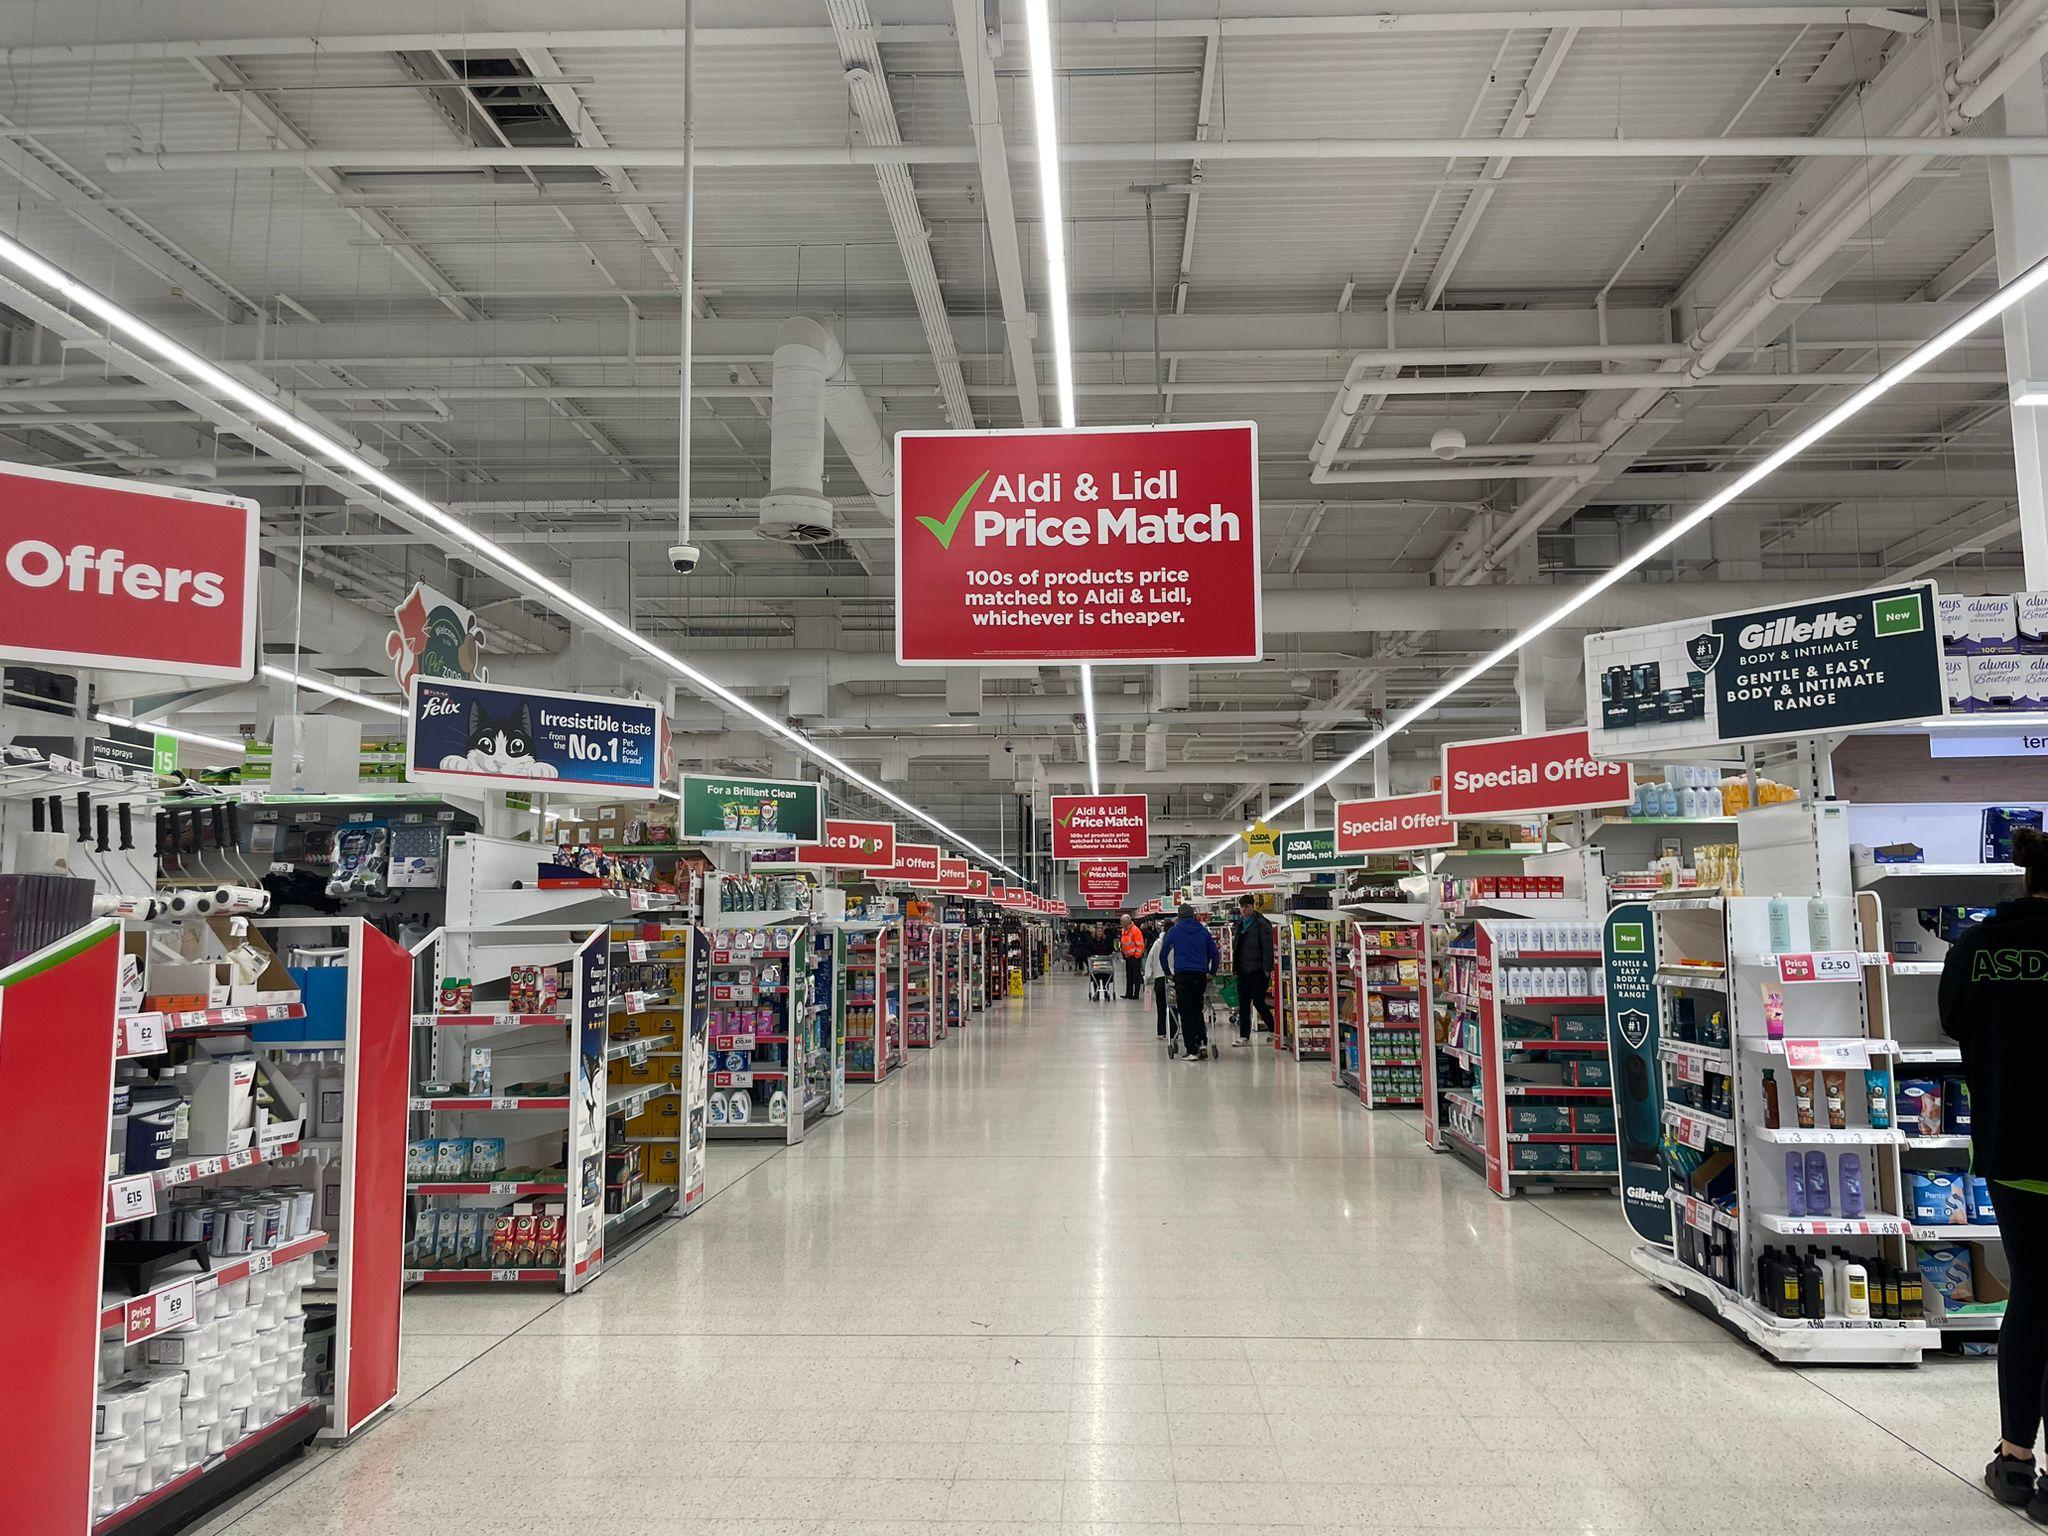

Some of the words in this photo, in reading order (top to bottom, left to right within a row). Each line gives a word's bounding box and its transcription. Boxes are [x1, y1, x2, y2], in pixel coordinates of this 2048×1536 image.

[988, 473, 1061, 503] Aldi
[1073, 472, 1099, 502] &
[1112, 469, 1178, 500] Lidl
[974, 508, 1092, 547] Price
[1097, 503, 1240, 545] Match
[6, 540, 225, 607] Offers
[966, 570, 1013, 586] 100s
[1018, 569, 1039, 585] of
[1044, 569, 1134, 588] products
[1140, 567, 1190, 586] price
[965, 590, 1051, 605] matched
[1057, 591, 1079, 604] to
[1084, 589, 1124, 604] Aldi
[1129, 588, 1144, 603] &
[1149, 587, 1192, 605] Lidl,
[1968, 599, 2008, 614] always
[972, 610, 1073, 626] whichever
[1078, 609, 1095, 624] is
[1100, 609, 1185, 626] cheaper.
[1885, 609, 1910, 622] New
[1739, 612, 1857, 650] Gillette
[1696, 643, 1713, 656] #1
[1740, 652, 1775, 666] BODY
[1781, 650, 1790, 660] &
[1794, 640, 1859, 658] INTIMATE
[1737, 668, 1799, 686] GENTLE
[1806, 666, 1819, 678] &
[1825, 657, 1871, 675] EASY
[1979, 658, 2020, 674] always
[1727, 686, 1773, 702] BODY
[1780, 684, 1792, 696] &
[1799, 670, 1885, 694] INTIMATE
[421, 697, 461, 720] felix
[1774, 693, 1836, 711] RANGE
[540, 709, 619, 732] Irresistible
[622, 721, 652, 736] taste
[548, 731, 566, 741] from
[622, 738, 634, 747] Pet
[553, 741, 566, 750] the
[568, 733, 618, 763] No.1
[622, 747, 638, 756] Food
[111, 746, 133, 760] sprays
[157, 751, 173, 771] 15
[1454, 762, 1538, 793] Special
[1544, 757, 1621, 781] Offers
[707, 784, 724, 795] For
[725, 788, 731, 796] a
[733, 786, 769, 798] Brilliant
[771, 787, 797, 799] Clean
[1076, 807, 1096, 815] Aldi
[1098, 806, 1106, 815] &
[1108, 806, 1127, 815] Lidl
[1072, 817, 1104, 828] Price
[1105, 816, 1143, 827] Match
[1342, 817, 1397, 836] Special
[1287, 840, 1313, 852] ASDA
[1318, 851, 1332, 859] not
[906, 858, 936, 869] Offers
[940, 869, 965, 878] Offers
[1206, 882, 1222, 890] Spec
[1620, 934, 1636, 942] New
[1785, 960, 1808, 968] Price
[1821, 961, 1850, 970] £2.50
[1971, 949, 2048, 982] ASD
[1616, 975, 1637, 983] BODY
[1613, 983, 1650, 991] INTIMATE
[1628, 1021, 1641, 1031] #1
[141, 1027, 153, 1040] £2
[1836, 1048, 1850, 1057] £3
[126, 1190, 143, 1204] £15
[1626, 1186, 1665, 1203] Gillette
[1925, 1191, 1945, 1199] Pants
[170, 1297, 182, 1312] £9
[131, 1306, 152, 1320] Price
